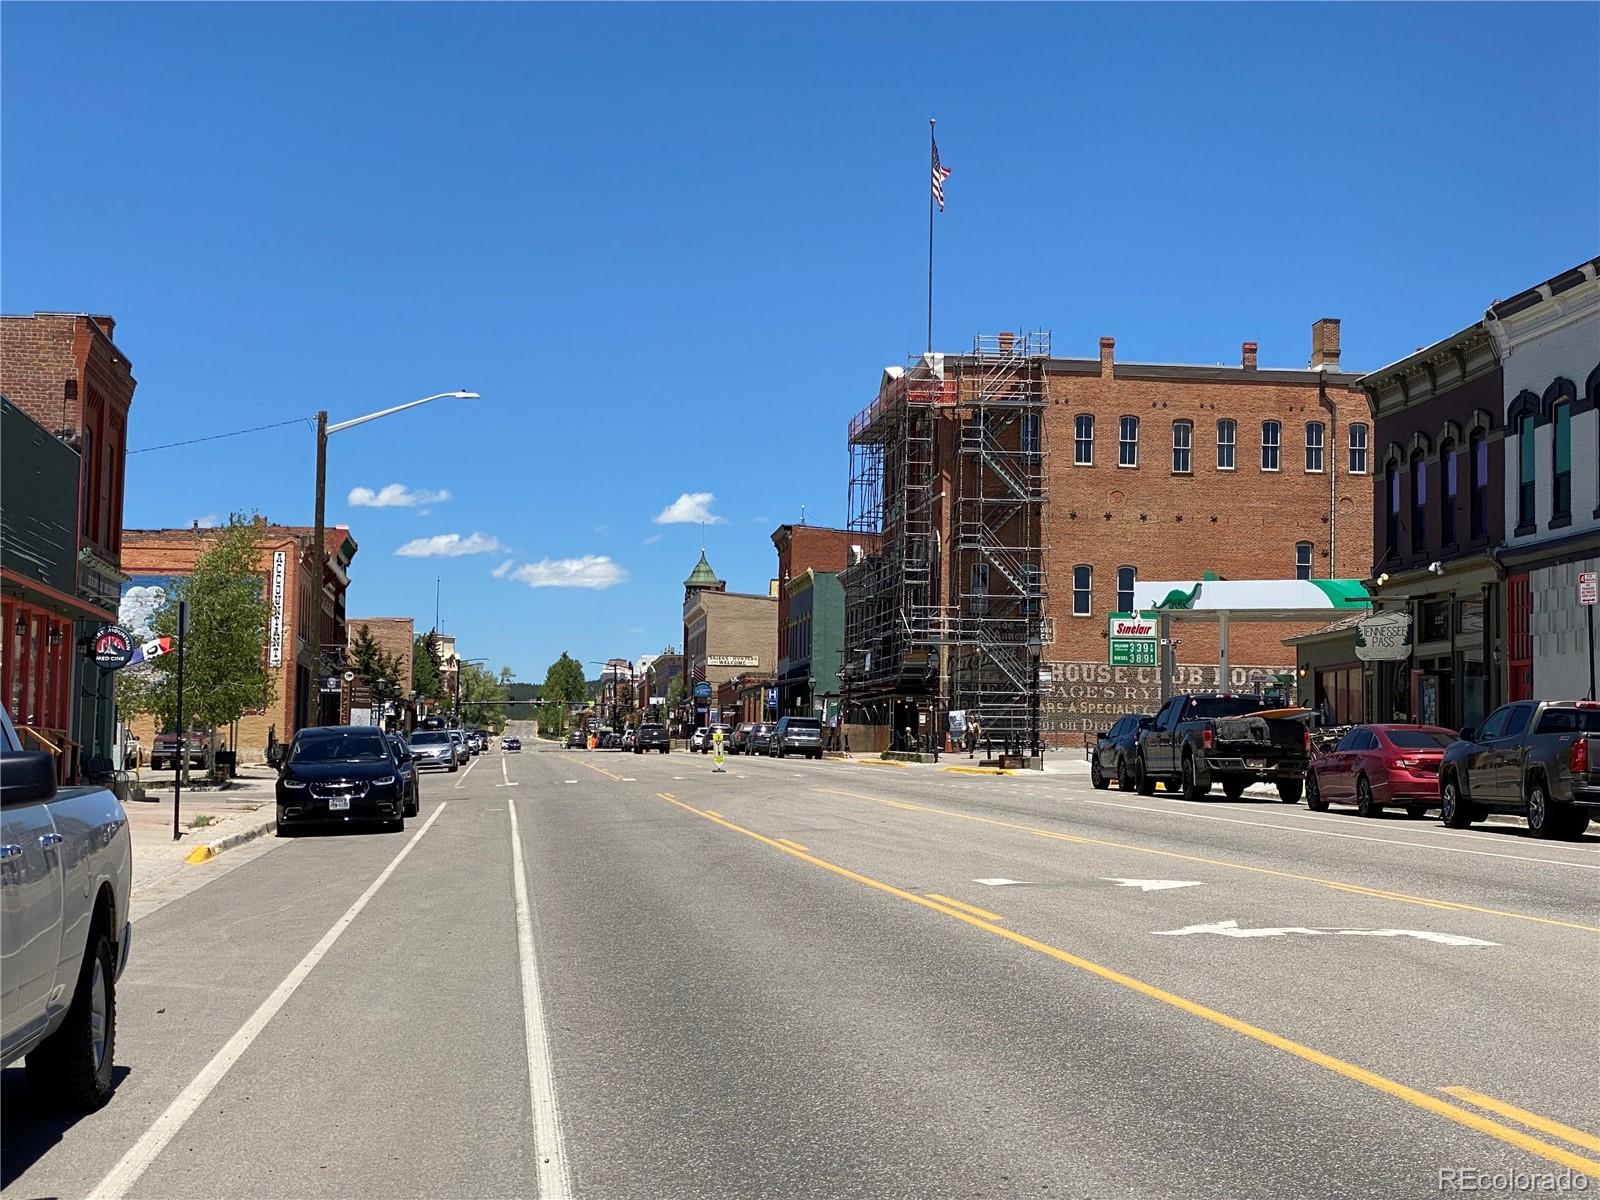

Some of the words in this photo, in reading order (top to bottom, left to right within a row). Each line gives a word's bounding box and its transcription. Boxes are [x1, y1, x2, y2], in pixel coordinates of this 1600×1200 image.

[1117, 623, 1153, 635] Sinclair
[1363, 626, 1406, 637] TENNESSEE
[1372, 636, 1395, 648] PASS
[1051, 664, 1128, 684] HOUSE
[1080, 702, 1149, 714] SPECIALTY
